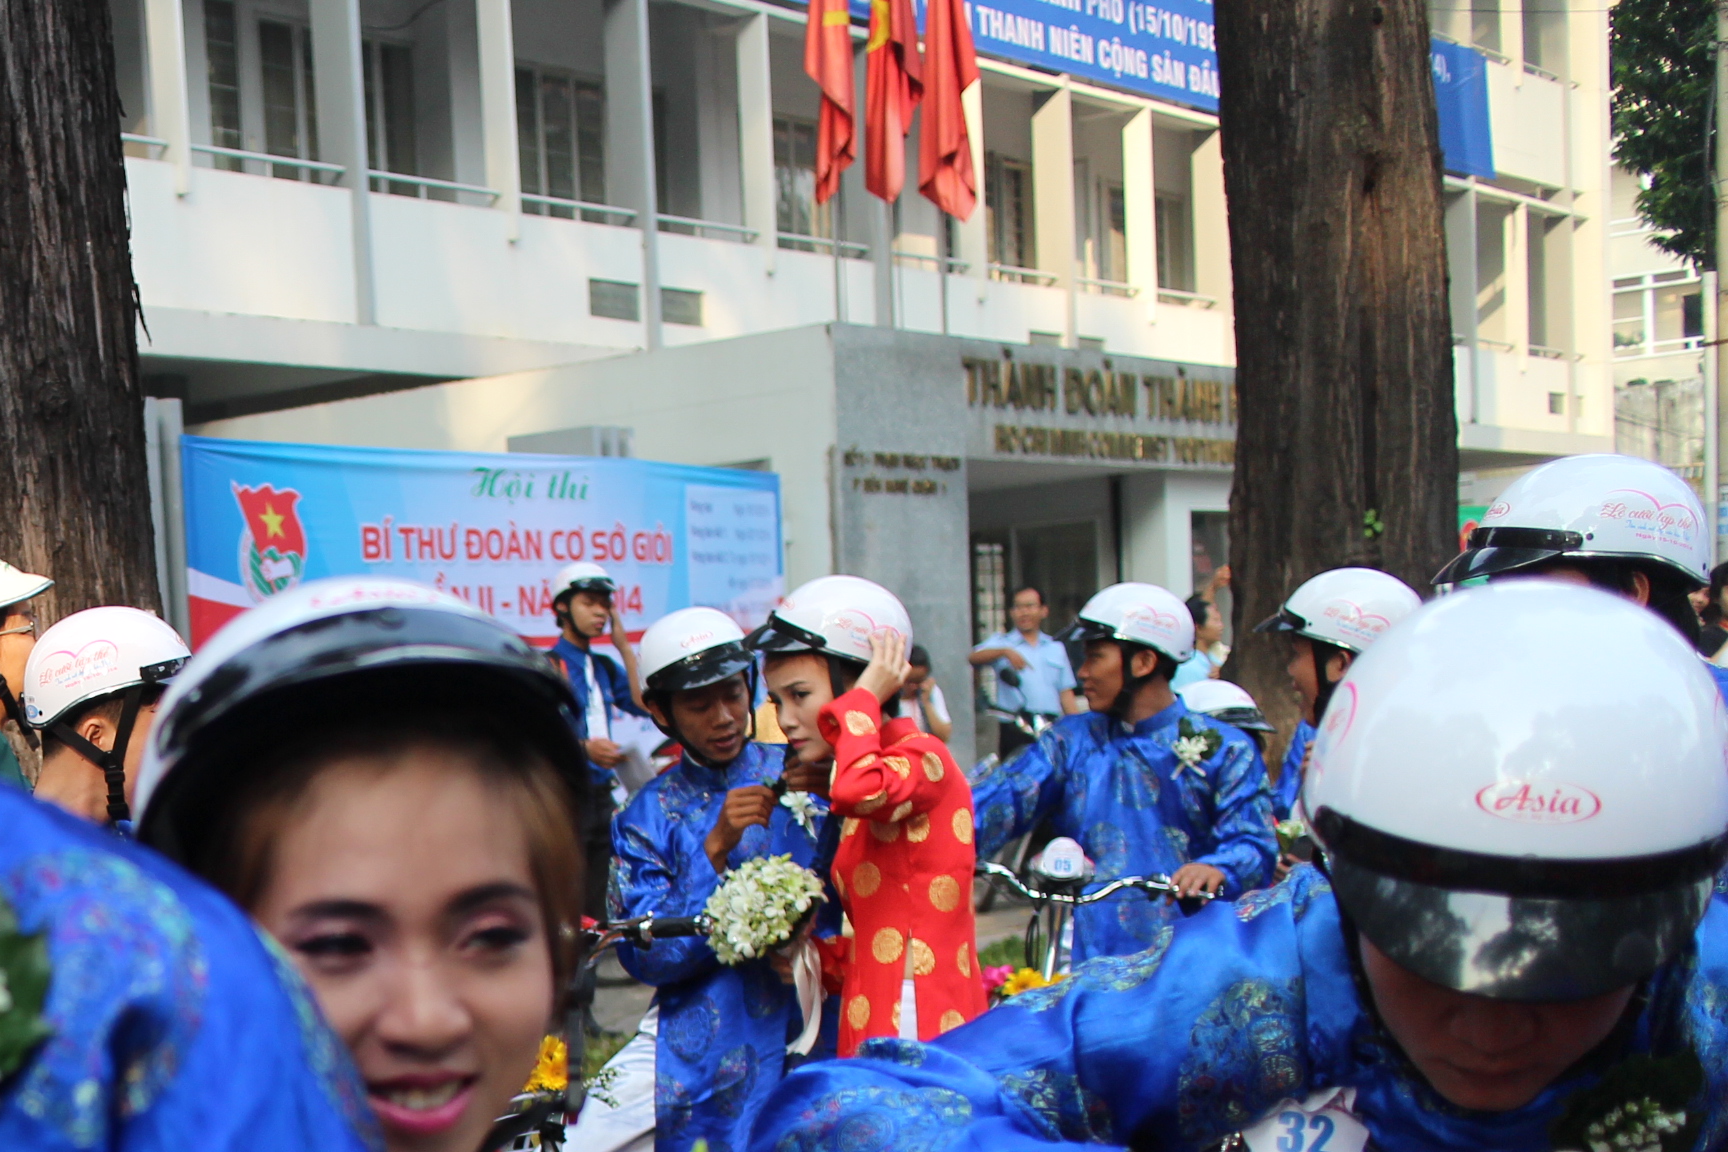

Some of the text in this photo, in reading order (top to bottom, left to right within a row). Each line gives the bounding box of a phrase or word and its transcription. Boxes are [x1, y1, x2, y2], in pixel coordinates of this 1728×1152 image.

[976, 5, 1186, 89] THANH NIÊN CỘNG SẢN
[471, 466, 590, 504] Hội thi
[362, 516, 391, 560] BÍ
[398, 522, 458, 561] THƯ
[464, 520, 542, 562] ĐOÀN
[550, 525, 585, 561] CƠ
[592, 521, 626, 561] SỞ
[519, 579, 554, 615] NĂ
[1494, 784, 1582, 815] Asia
